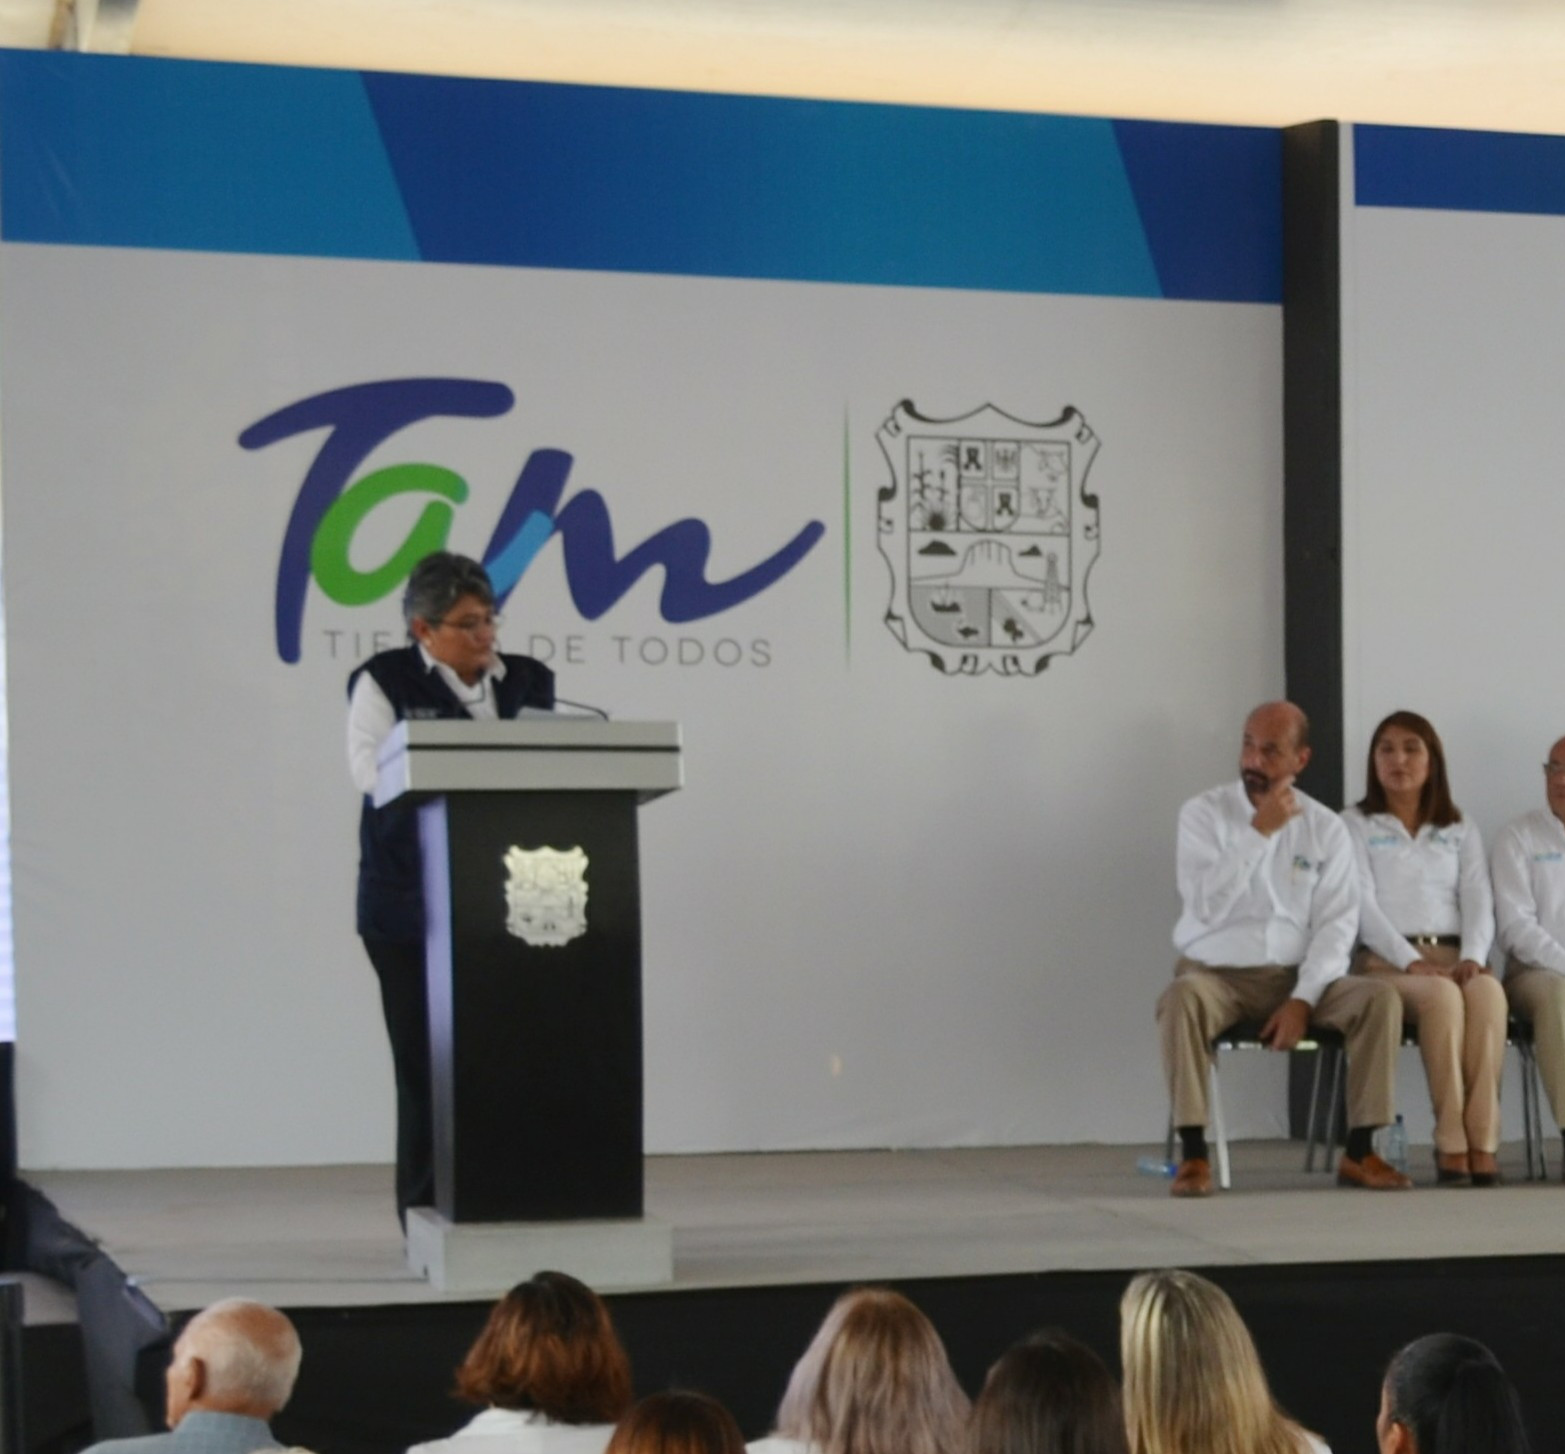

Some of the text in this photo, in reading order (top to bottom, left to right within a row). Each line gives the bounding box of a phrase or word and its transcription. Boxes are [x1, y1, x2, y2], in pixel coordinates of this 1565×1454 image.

[239, 377, 826, 665] Tam
[529, 634, 586, 664] DE
[612, 636, 772, 667] TODOS
